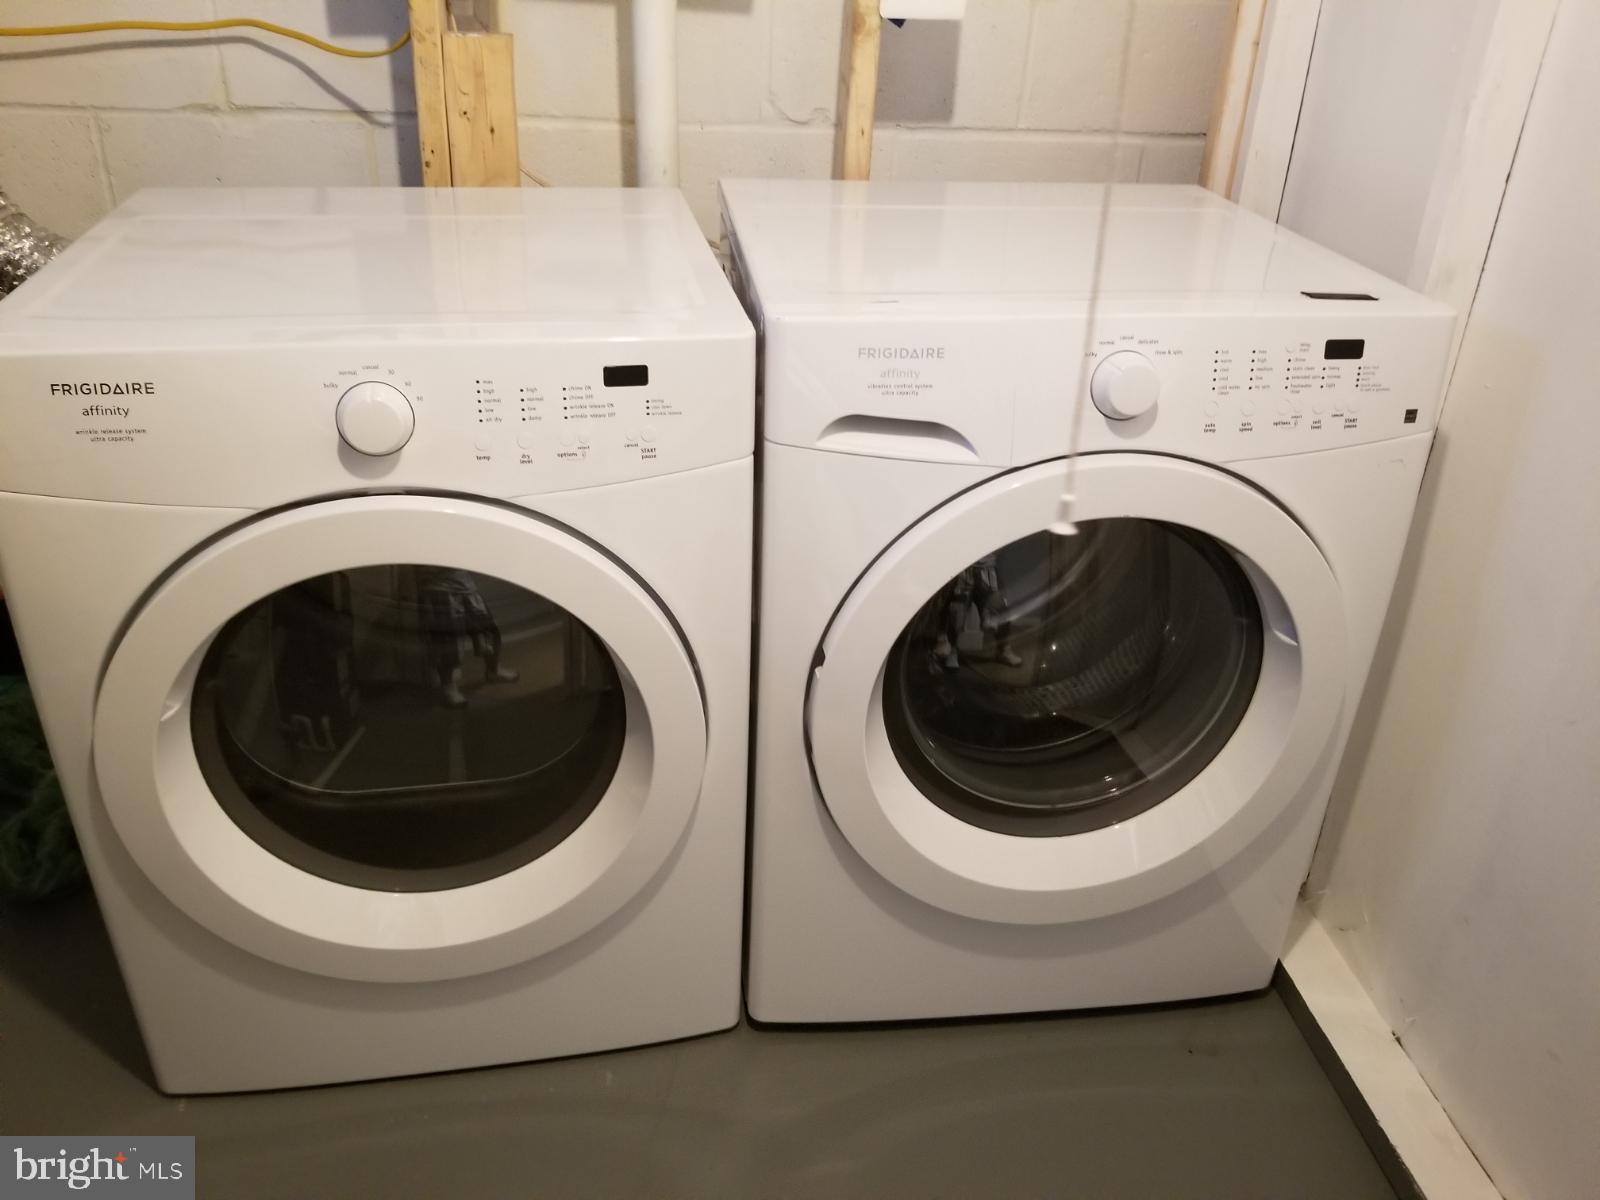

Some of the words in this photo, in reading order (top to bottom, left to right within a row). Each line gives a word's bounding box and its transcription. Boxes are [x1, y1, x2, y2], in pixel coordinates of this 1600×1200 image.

[857, 347, 945, 359] FRIGIDAIRE
[880, 367, 920, 380] affinity
[50, 382, 155, 397] FRIGIDAIRE
[82, 405, 129, 418] affinity
